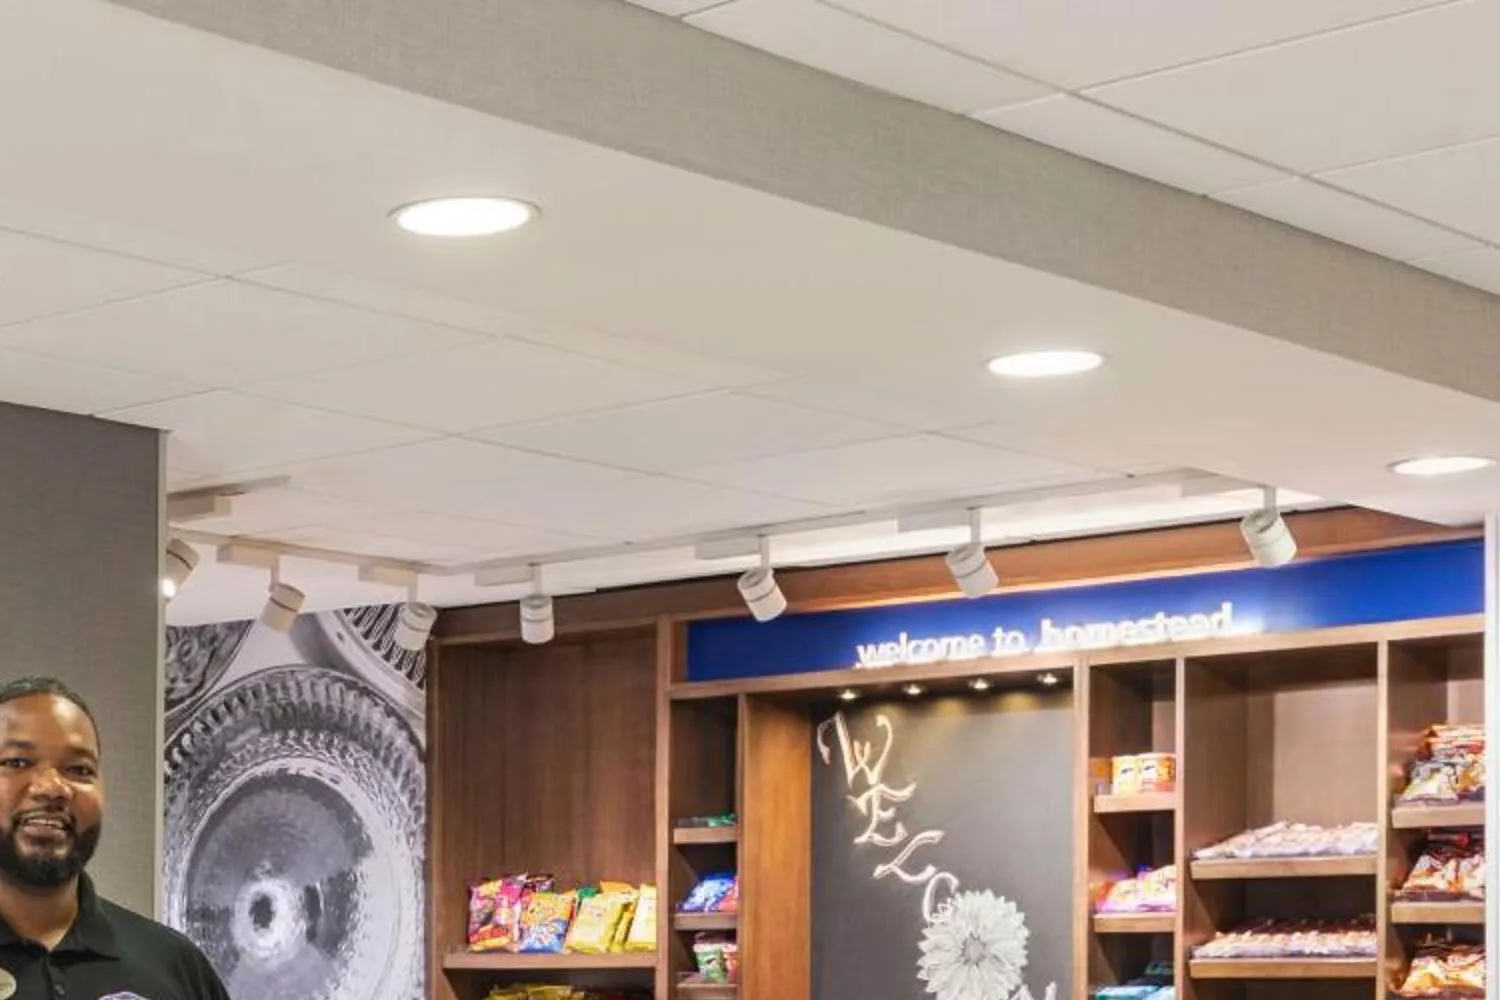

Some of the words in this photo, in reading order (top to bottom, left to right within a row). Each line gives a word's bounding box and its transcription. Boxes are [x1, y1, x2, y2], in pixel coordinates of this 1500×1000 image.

[857, 632, 986, 667] welcome
[992, 627, 1027, 656] to
[1041, 600, 1233, 648] homestead
